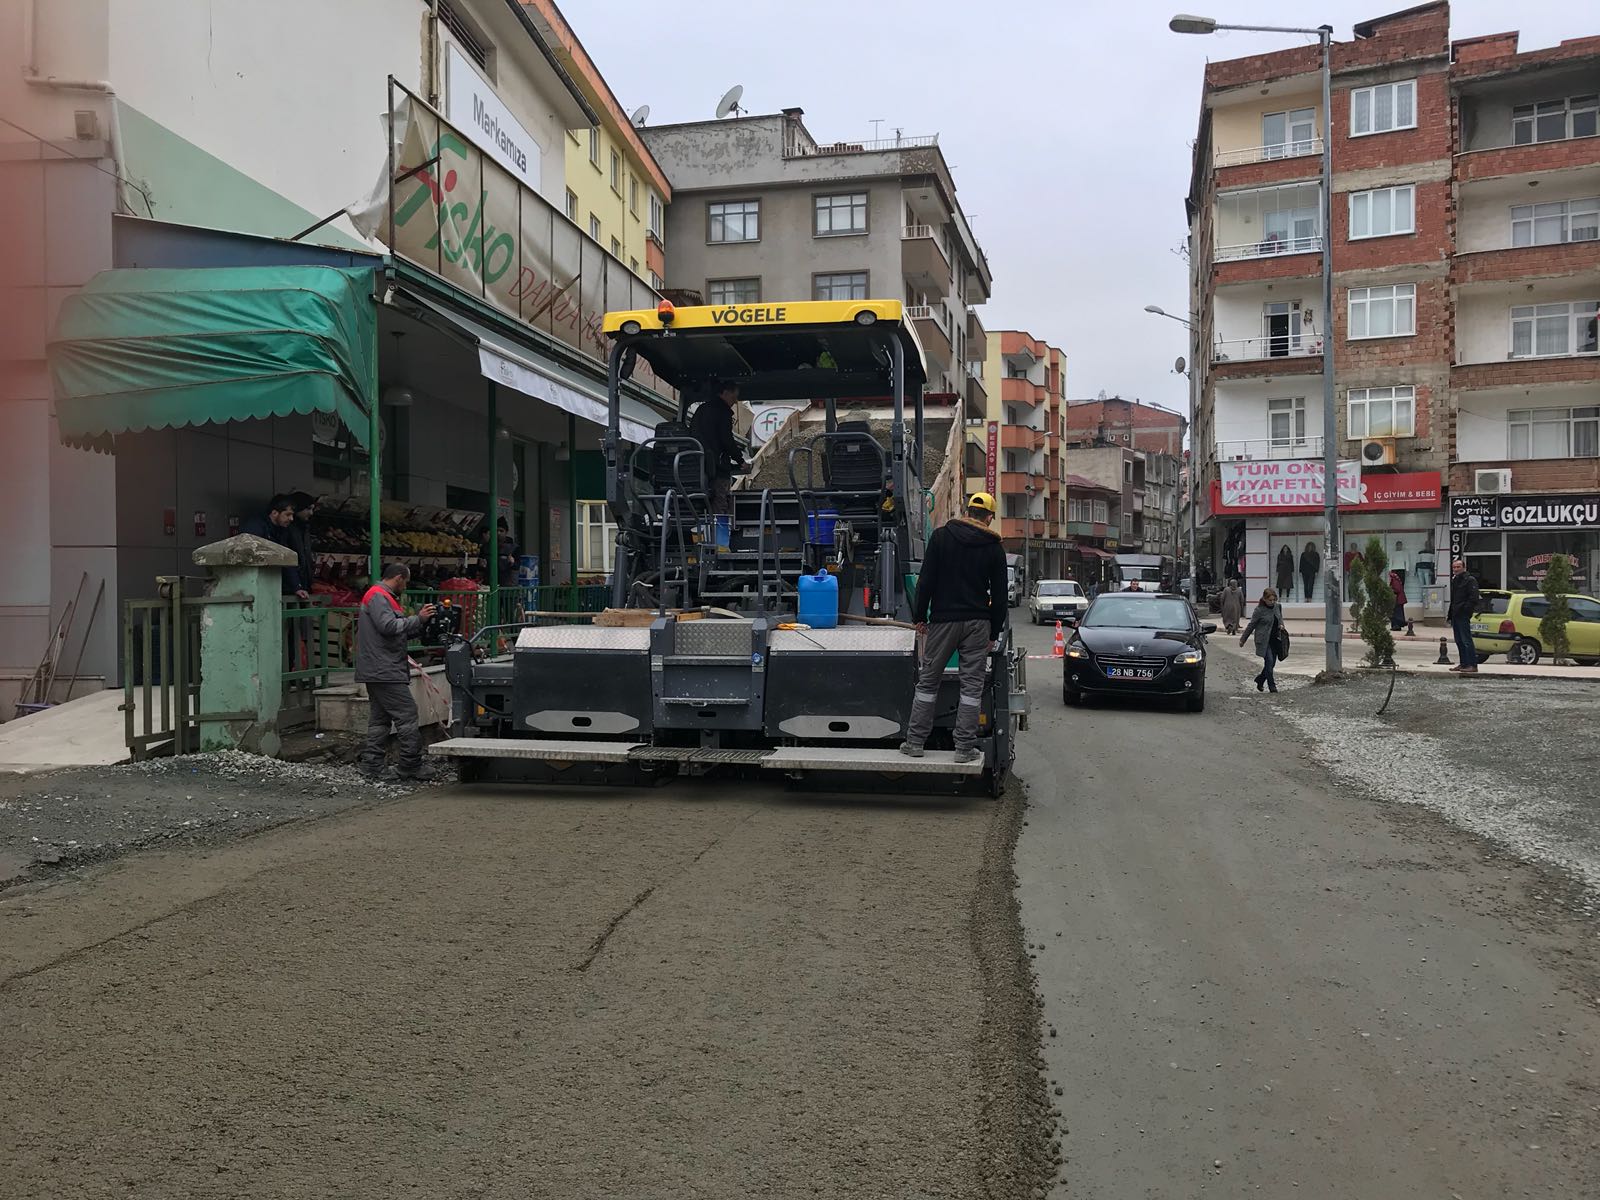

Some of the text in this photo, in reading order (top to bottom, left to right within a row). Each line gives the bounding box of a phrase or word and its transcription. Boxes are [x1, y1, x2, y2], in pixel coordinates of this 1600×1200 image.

[711, 306, 787, 324] VÖGELE
[1233, 462, 1280, 476] TÜM
[1226, 475, 1357, 491] KIYAFETLRİ
[1238, 494, 1327, 505] BULUNU
[1384, 490, 1406, 499] GİYİM
[1415, 489, 1436, 498] BEBE
[1453, 497, 1496, 506] AHMET
[1457, 505, 1491, 516] OPTİK
[1111, 668, 1152, 678] 28 NB 756
